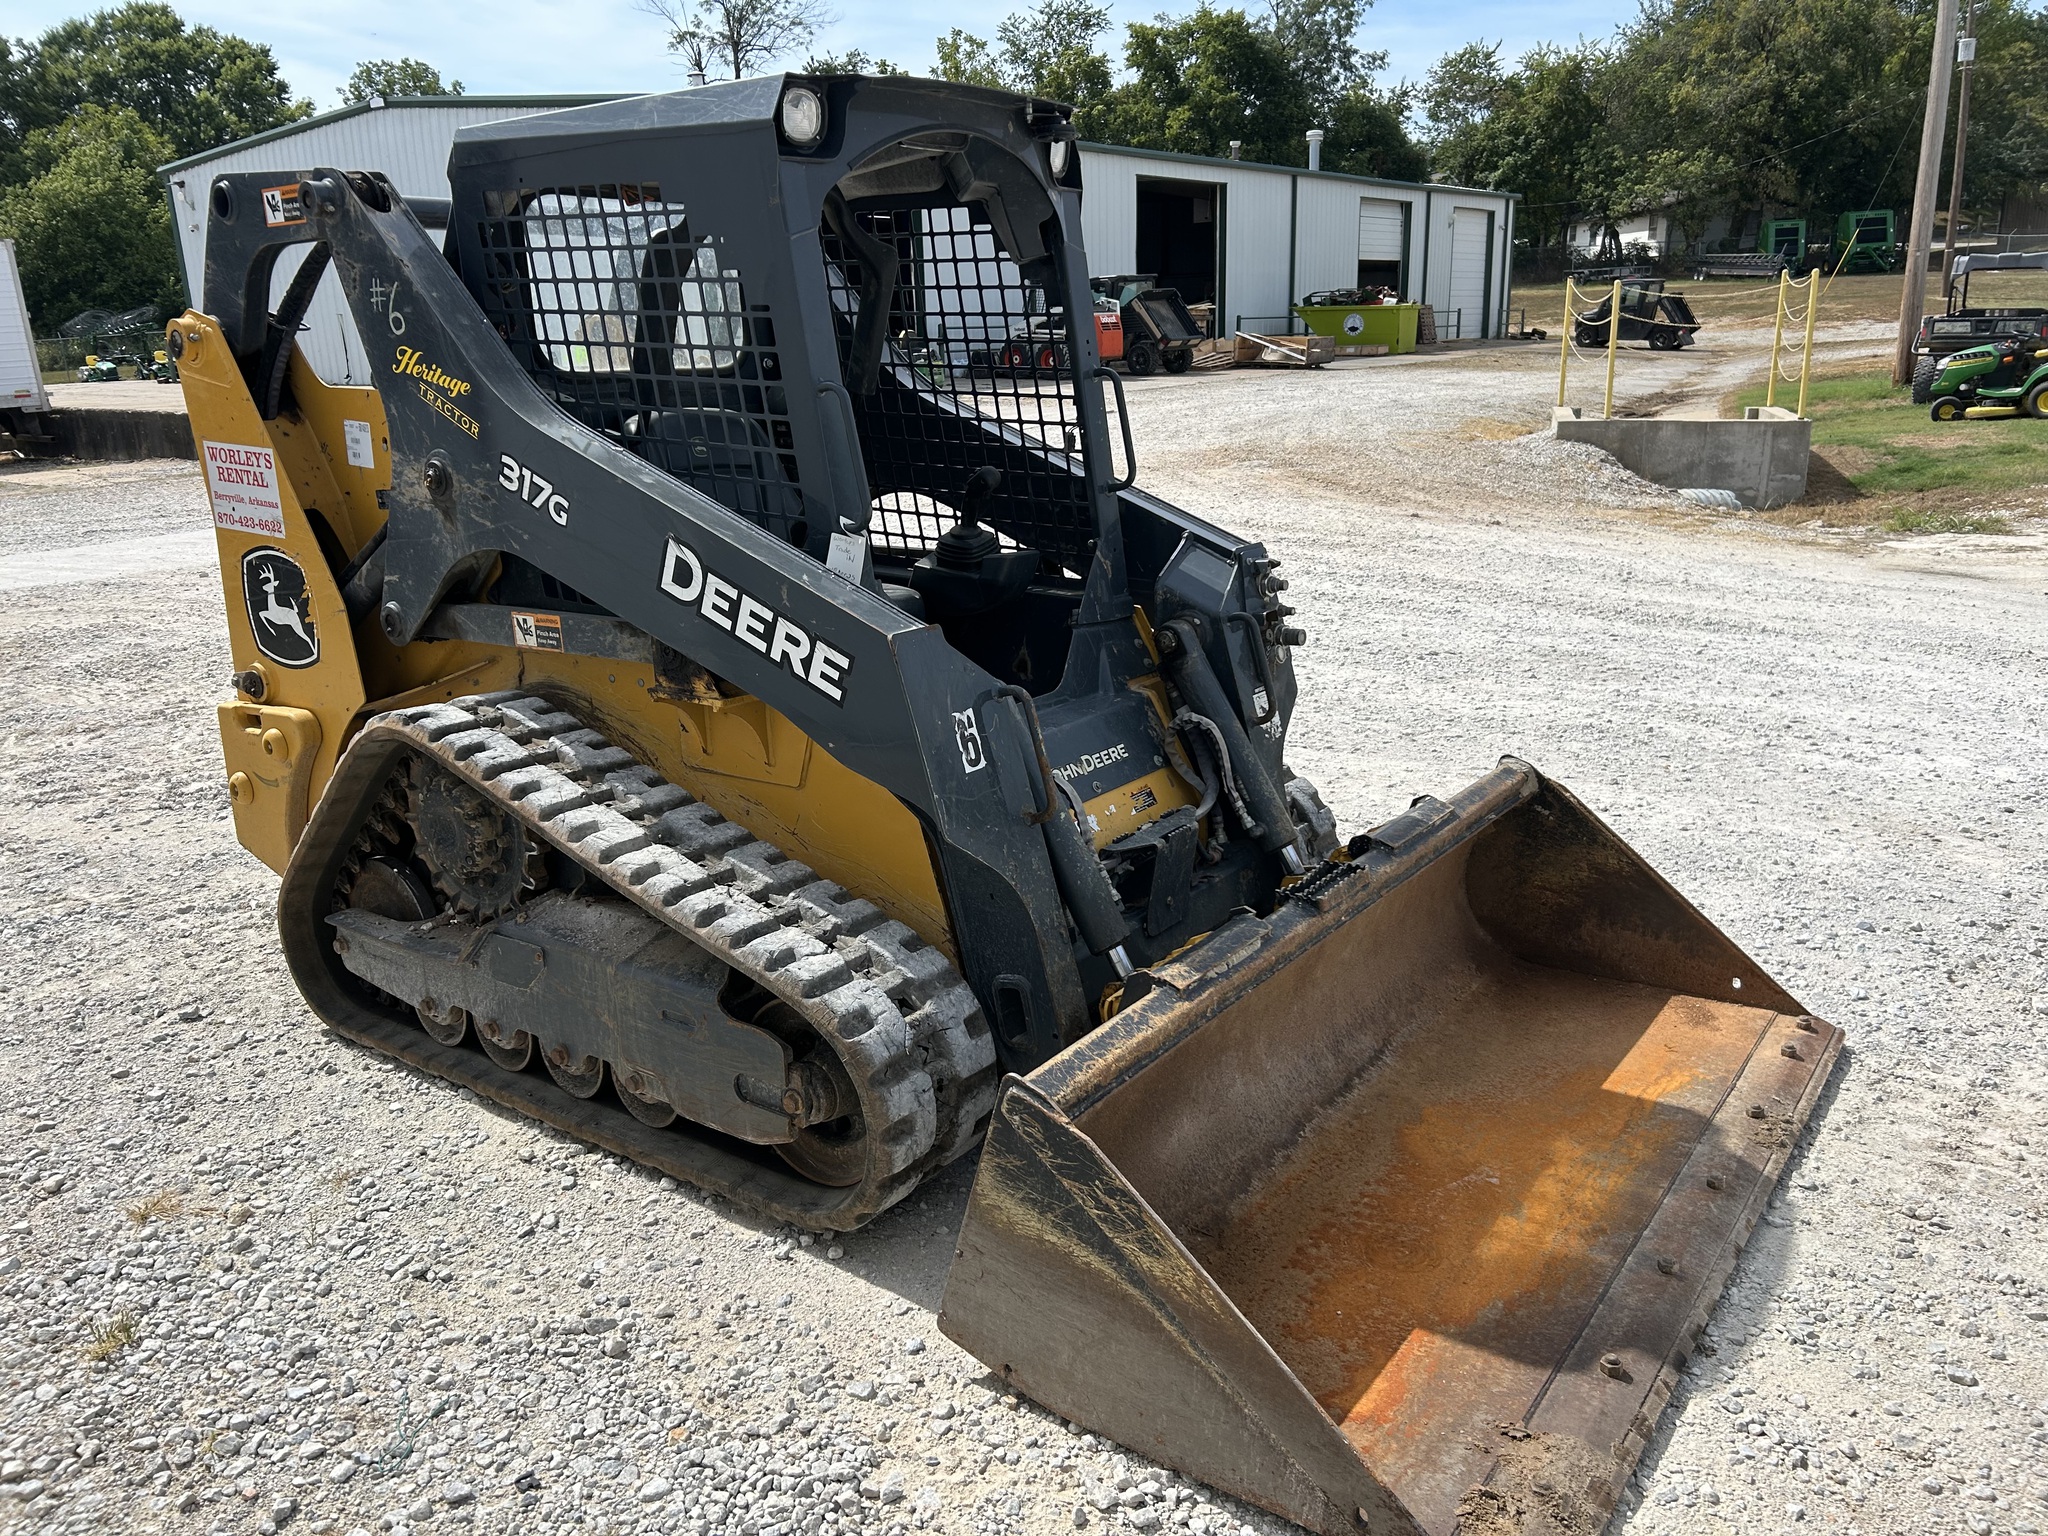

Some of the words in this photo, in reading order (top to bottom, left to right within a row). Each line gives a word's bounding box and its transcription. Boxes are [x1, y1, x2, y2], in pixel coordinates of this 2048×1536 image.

[392, 345, 471, 397] Heritage
[419, 384, 480, 437] TRACTOR
[207, 446, 273, 470] WORLEY'S
[216, 466, 269, 488] RENTAL
[499, 454, 570, 526] 317G
[214, 491, 247, 505] Berryville,
[249, 496, 279, 509] Arkansas
[217, 512, 283, 533] 870-423-6622
[660, 537, 851, 702] DEERE
[1080, 743, 1129, 774] DEERE
